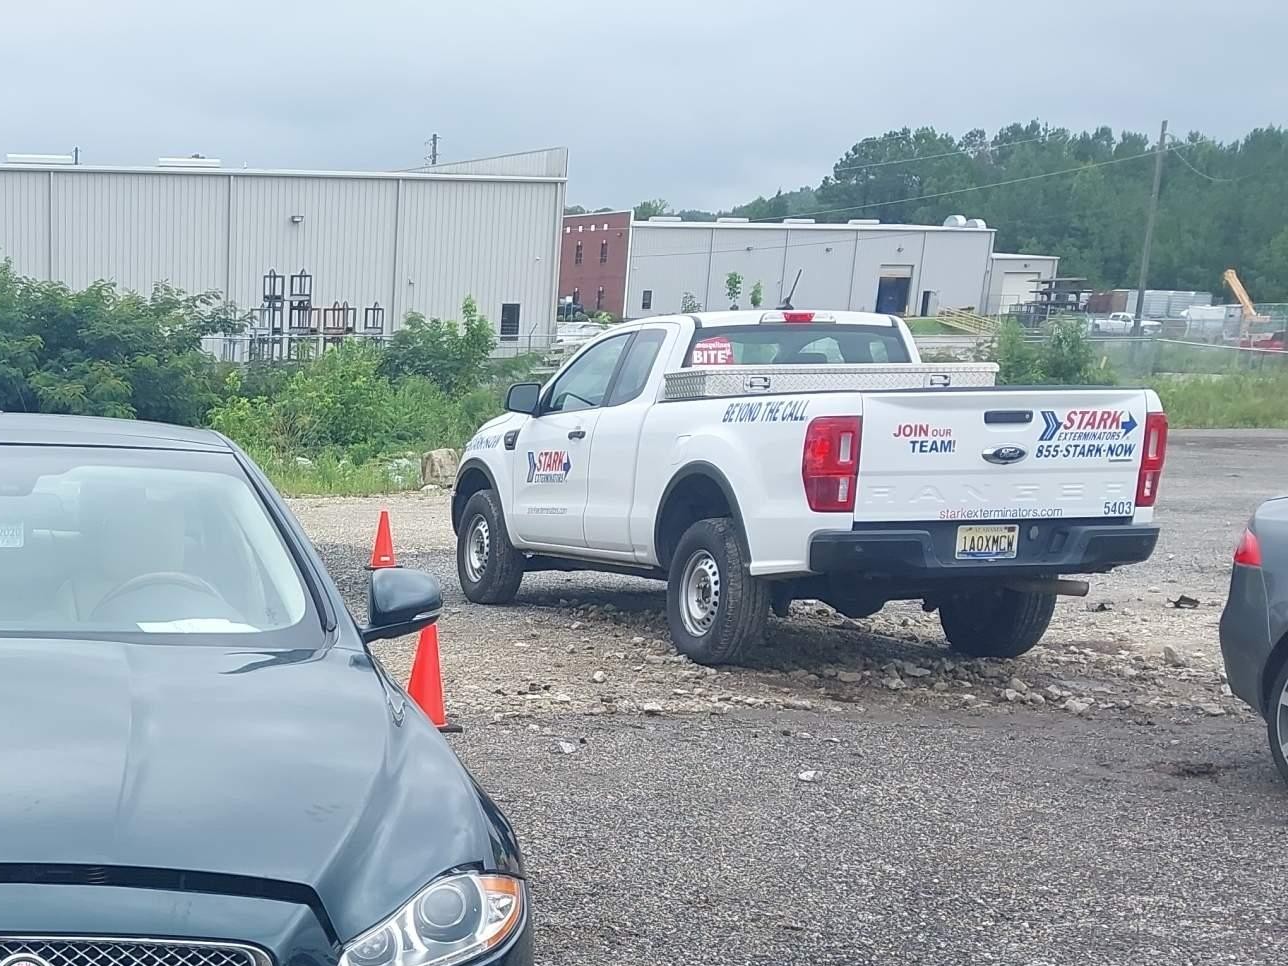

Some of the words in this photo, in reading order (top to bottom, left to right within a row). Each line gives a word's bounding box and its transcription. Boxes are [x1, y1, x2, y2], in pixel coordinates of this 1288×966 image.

[692, 350, 728, 364] BITE
[722, 402, 763, 423] BEYOND
[761, 401, 785, 422] THE
[1063, 410, 1124, 431] STARK
[893, 424, 930, 438] JOIN
[931, 428, 952, 438] OUR
[1057, 431, 1122, 442] EXTERMINATORS
[909, 439, 957, 454] TEAM!
[1035, 443, 1137, 459] 855-STARK-NOW
[536, 451, 566, 472] STARK
[939, 506, 1063, 520] starkexterminators.com
[1103, 501, 1133, 516] 5403
